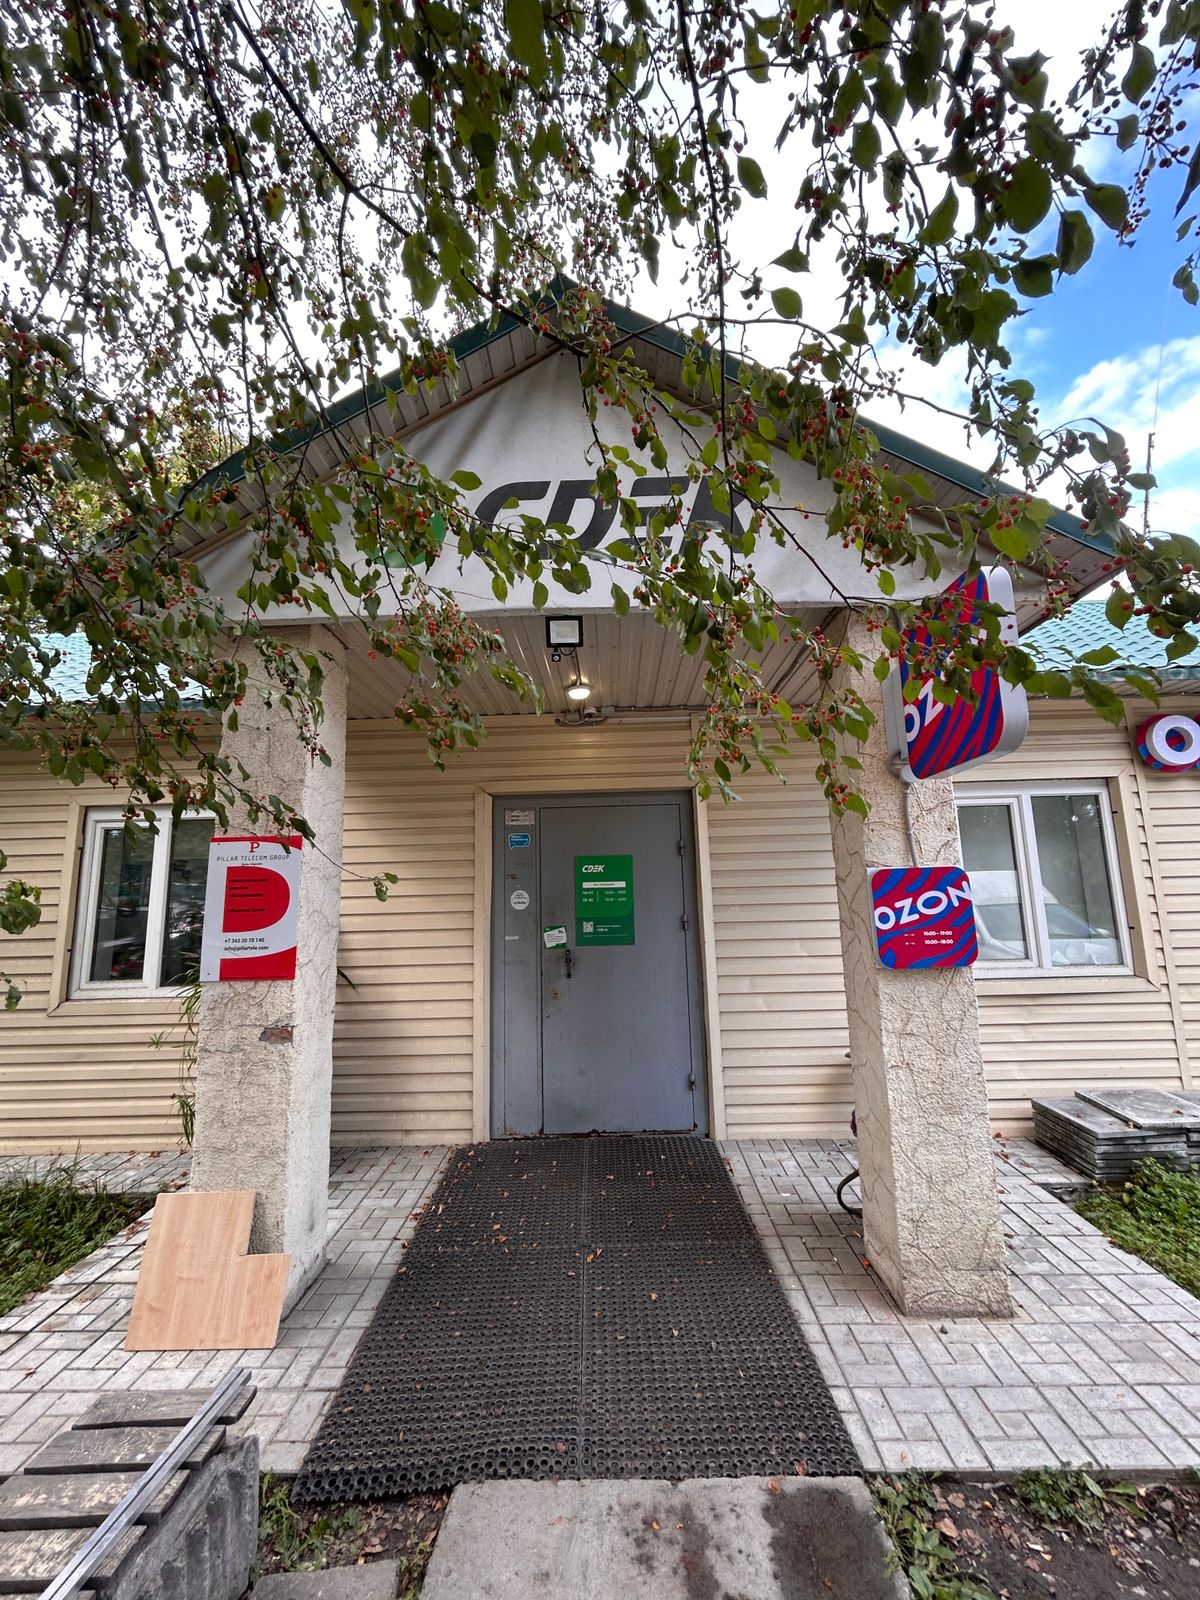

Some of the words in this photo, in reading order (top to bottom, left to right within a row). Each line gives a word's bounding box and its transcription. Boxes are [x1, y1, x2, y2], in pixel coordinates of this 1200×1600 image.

[469, 476, 750, 560] CDEK
[582, 864, 605, 873] CDEK
[874, 880, 973, 930] OZON
